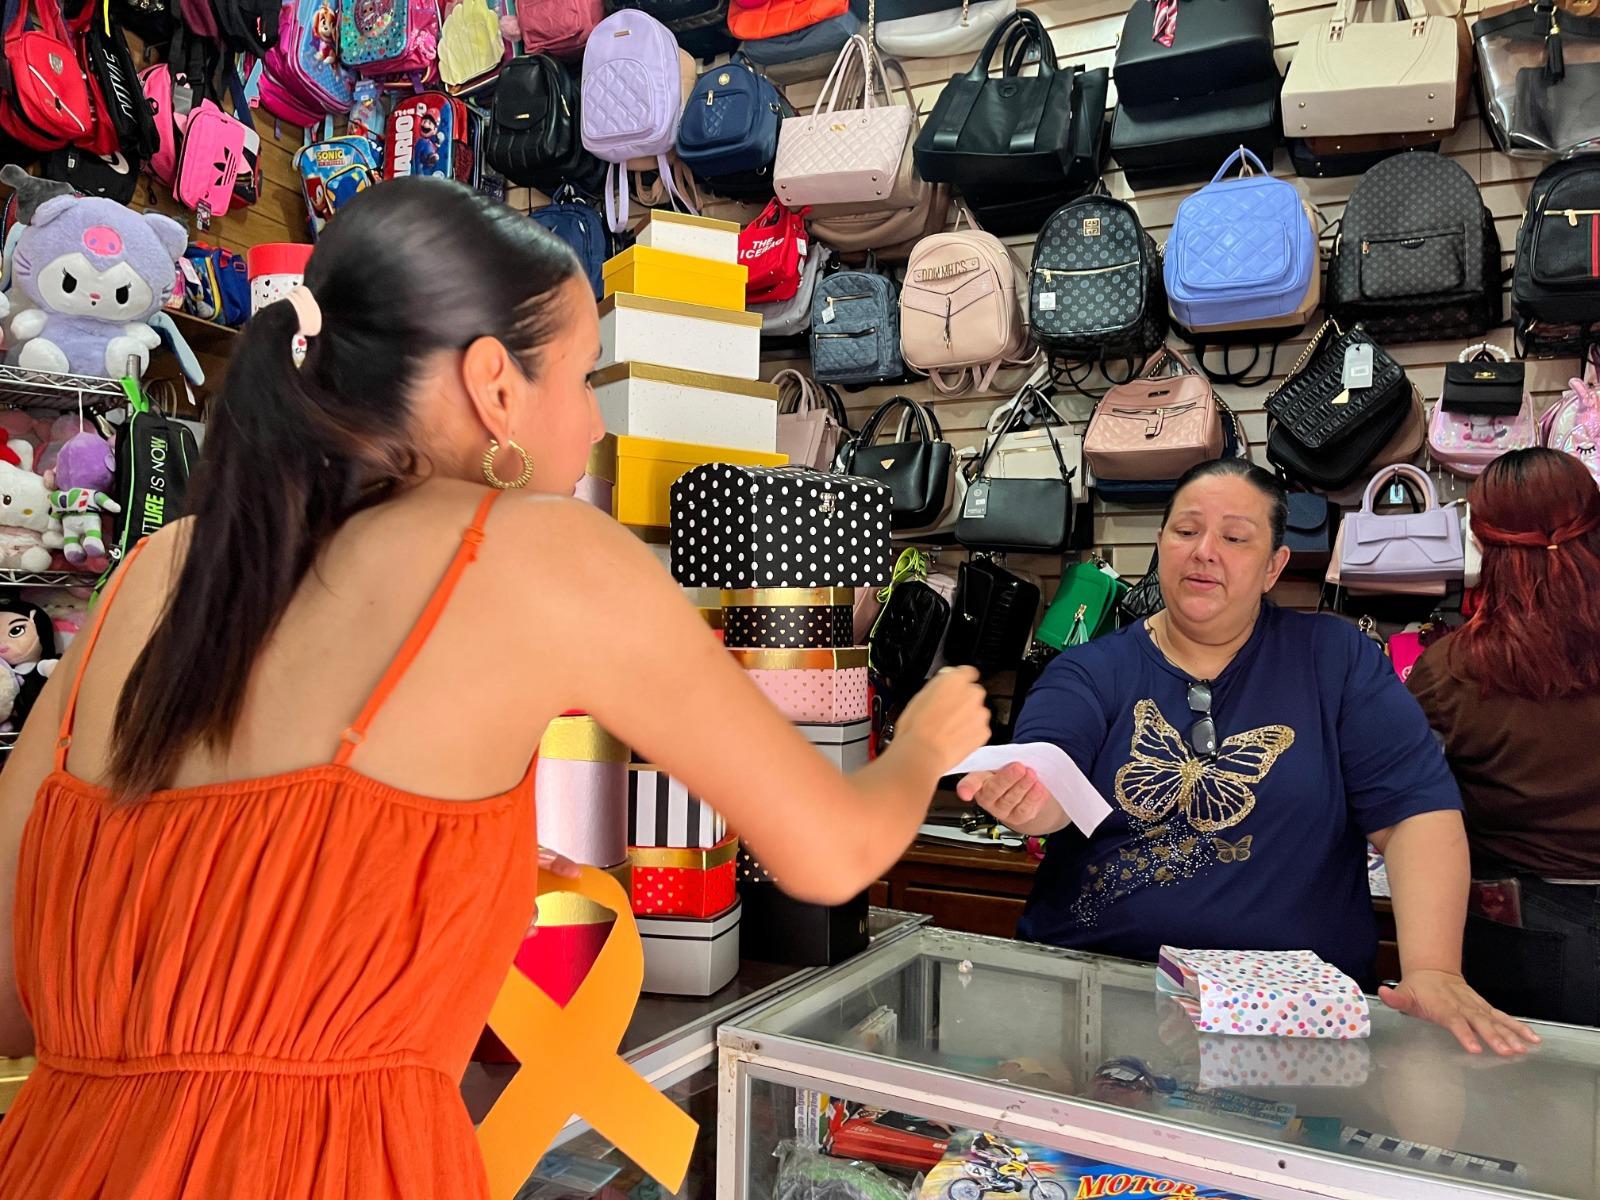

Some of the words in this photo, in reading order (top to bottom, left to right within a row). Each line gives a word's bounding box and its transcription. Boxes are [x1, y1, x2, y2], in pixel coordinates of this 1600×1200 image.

[316, 149, 344, 160] SONIC
[393, 114, 414, 178] ARIO
[752, 236, 775, 250] THE
[150, 435, 168, 473] NOW
[150, 475, 165, 492] IS
[142, 492, 165, 534] TURE
[1074, 1174, 1199, 1200] MOTOR
